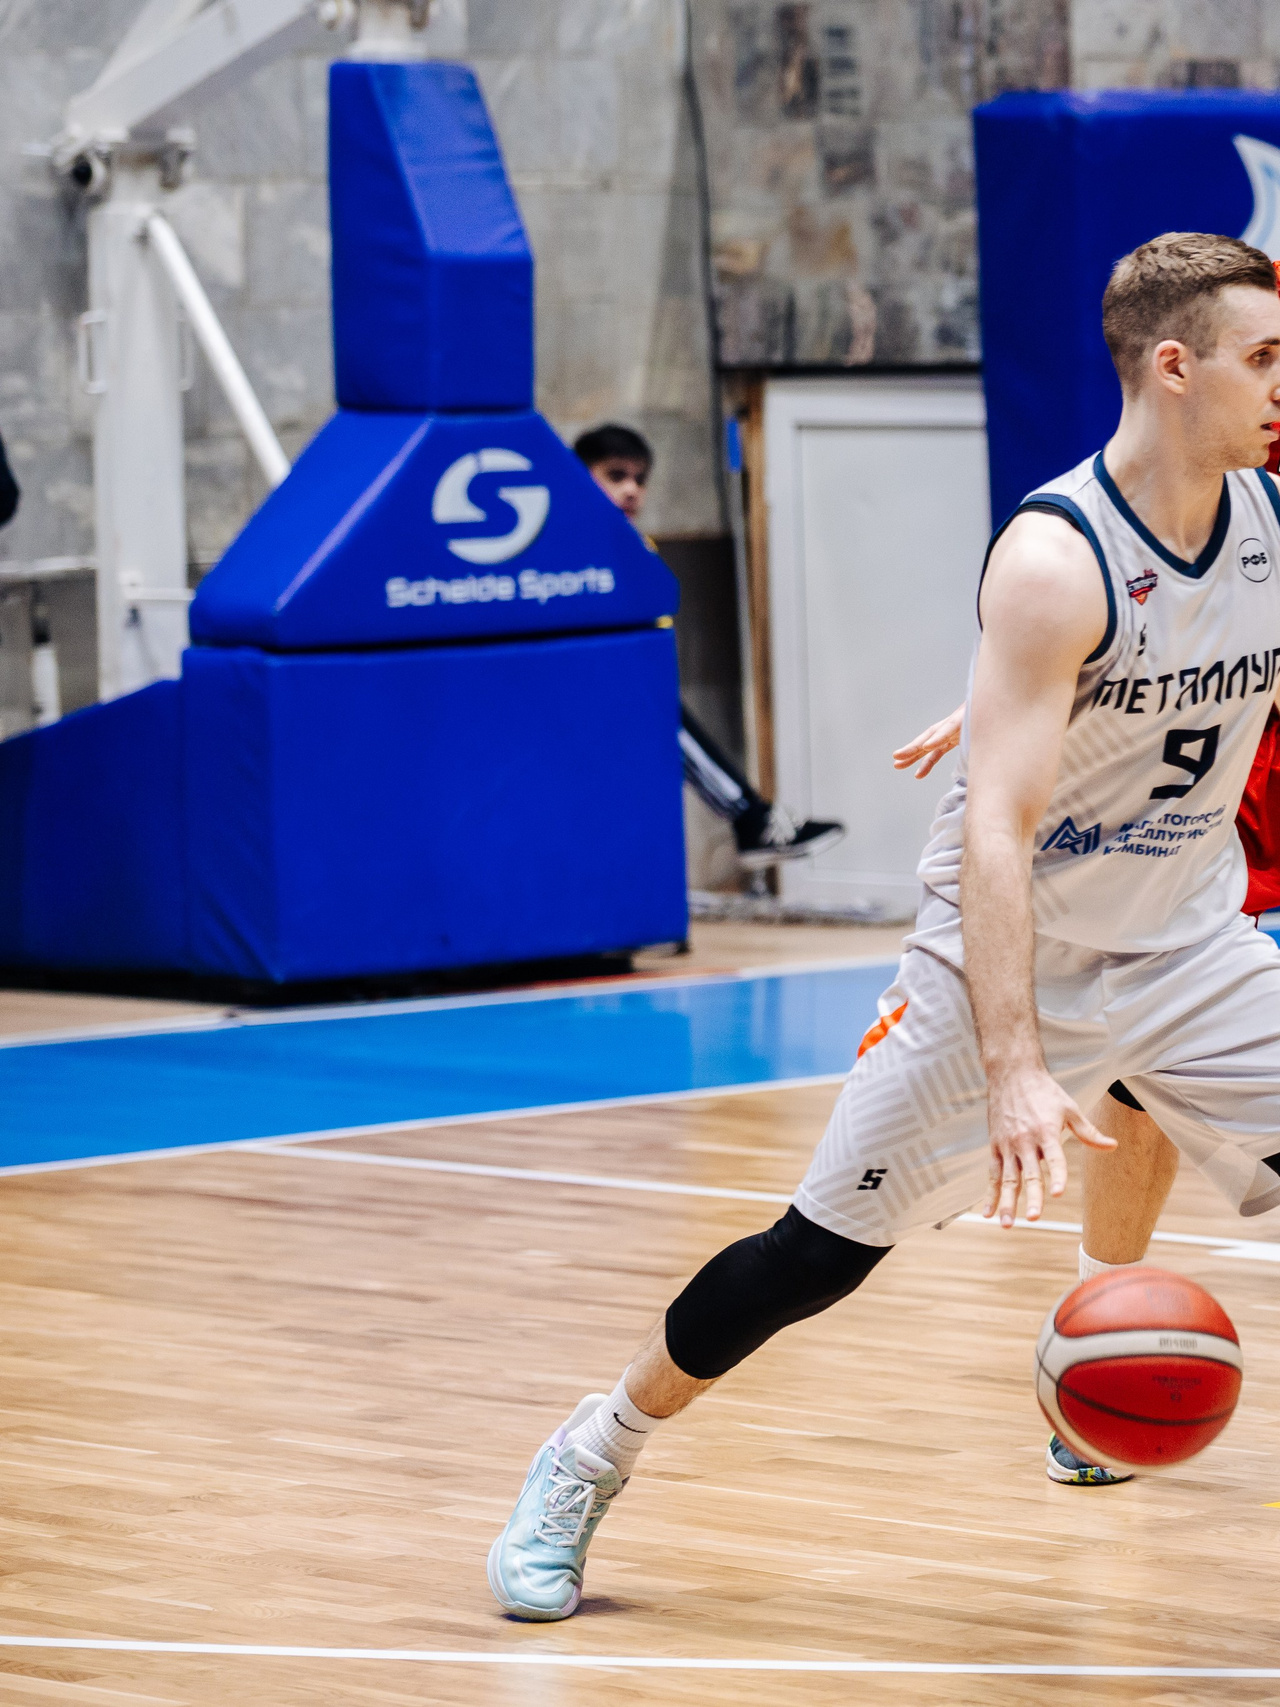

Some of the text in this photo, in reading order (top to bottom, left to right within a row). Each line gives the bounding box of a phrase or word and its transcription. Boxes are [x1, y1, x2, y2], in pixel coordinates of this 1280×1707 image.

[1241, 552, 1268, 568] РФБ
[518, 566, 615, 604] Sports
[1149, 723, 1222, 800] 9
